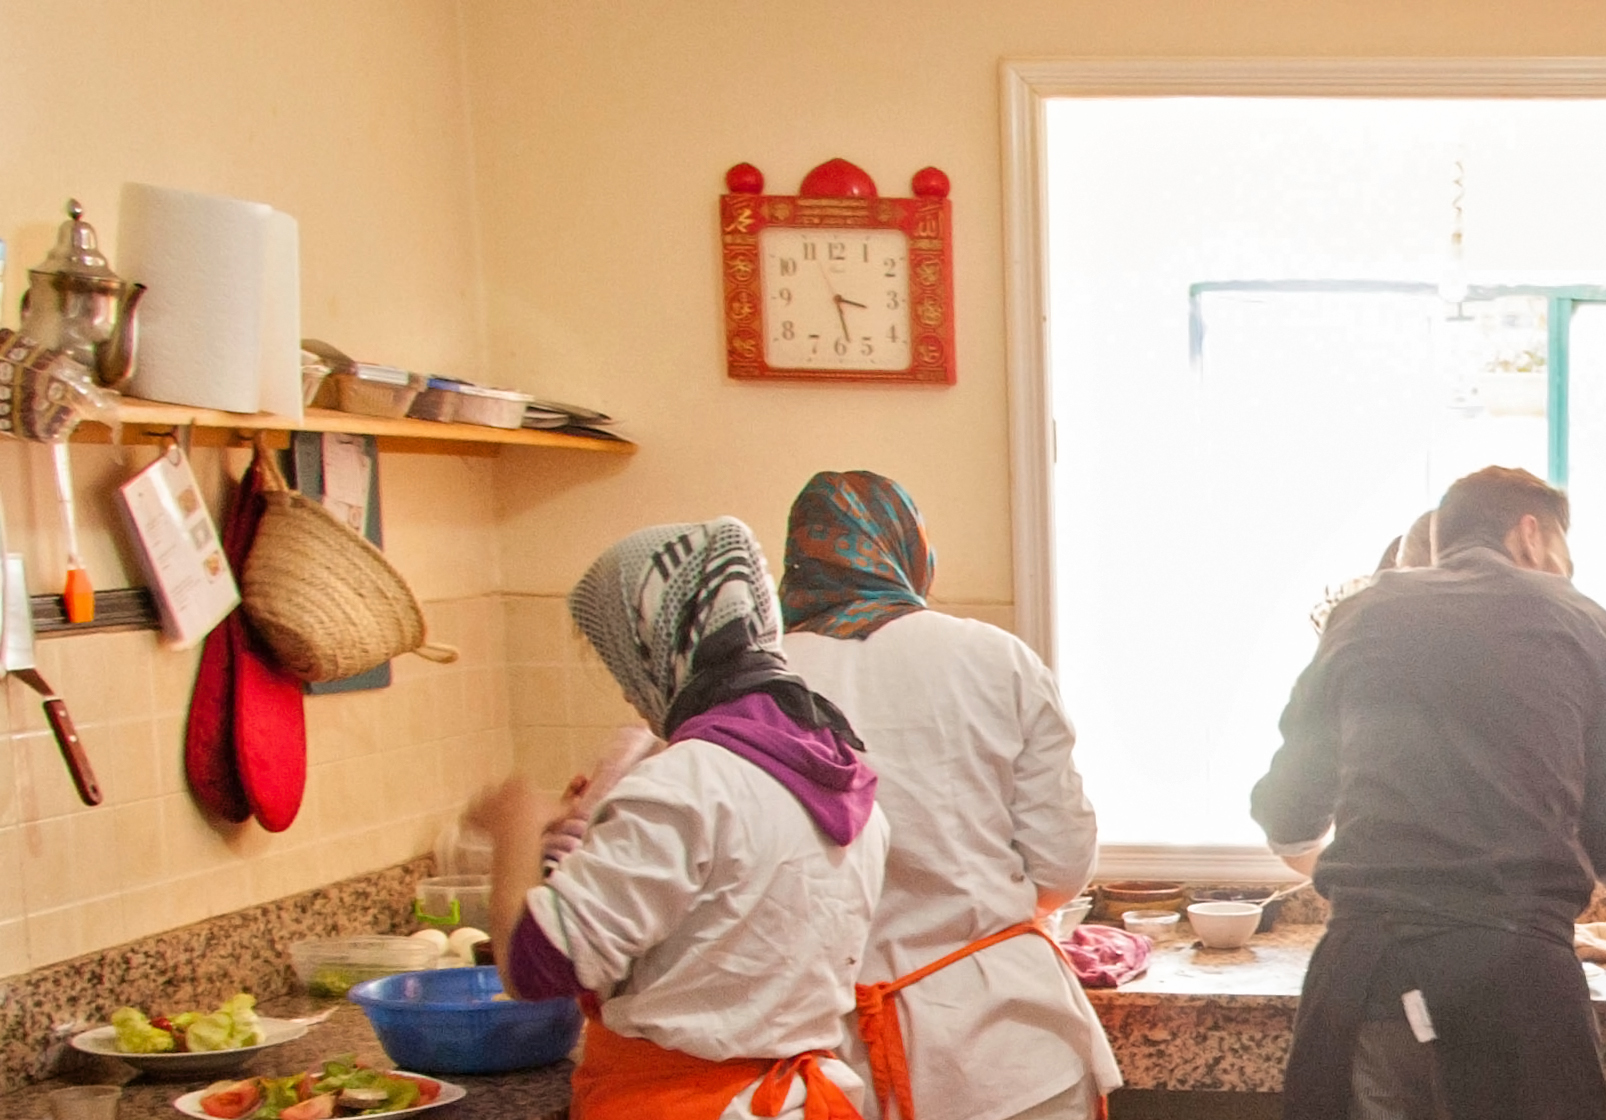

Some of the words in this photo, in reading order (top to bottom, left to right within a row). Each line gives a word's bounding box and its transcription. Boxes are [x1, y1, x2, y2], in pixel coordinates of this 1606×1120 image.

[802, 242, 817, 260] 11
[827, 242, 845, 261] 12
[779, 257, 797, 277] 10
[882, 257, 896, 278] 2
[778, 287, 792, 306] 9
[886, 290, 900, 311] 3
[781, 320, 795, 340] 8
[885, 324, 898, 343] 4
[808, 334, 820, 355] 7
[833, 338, 847, 356] 6
[860, 336, 874, 356] 5
